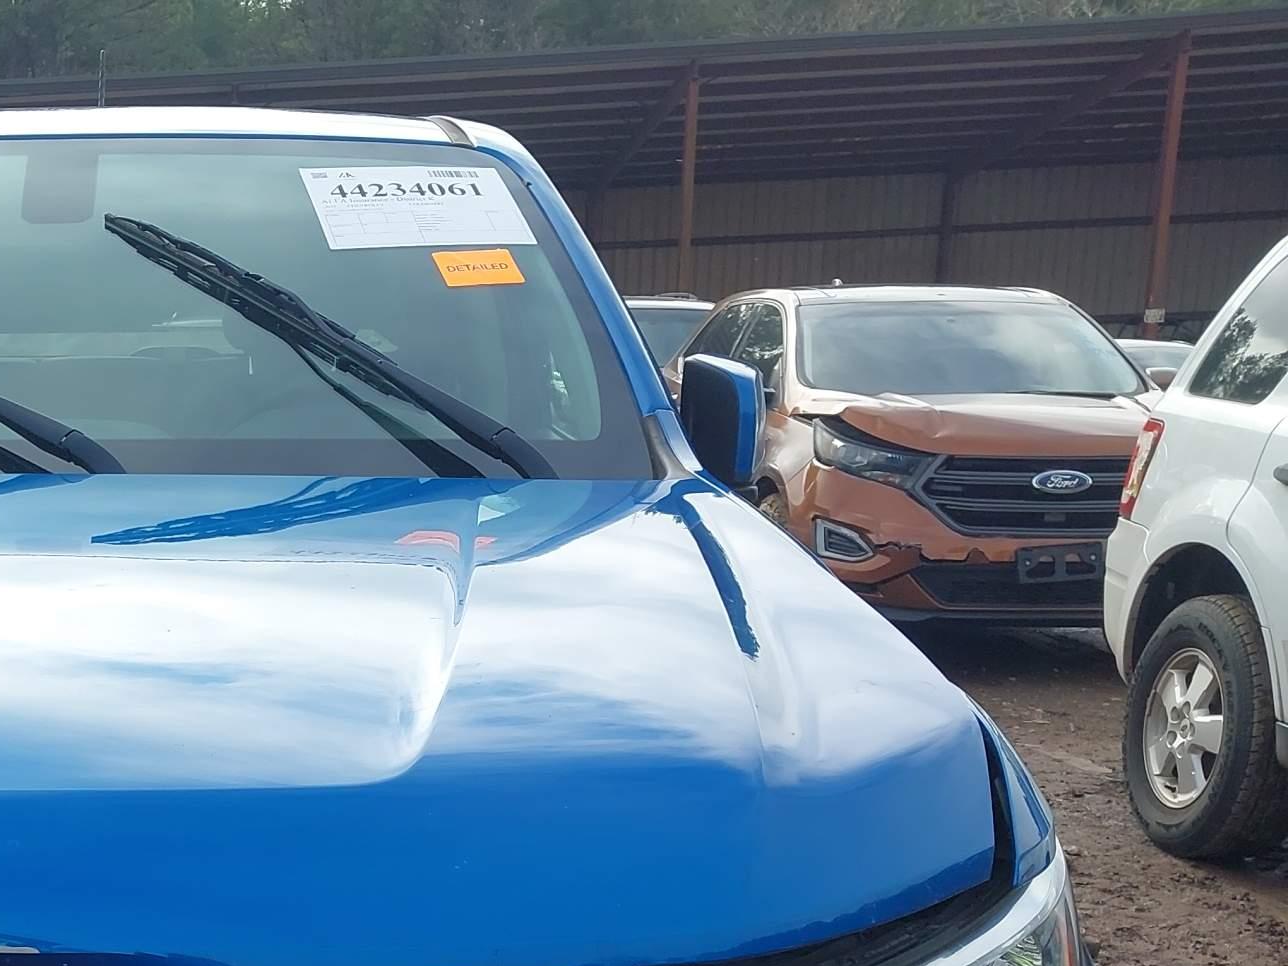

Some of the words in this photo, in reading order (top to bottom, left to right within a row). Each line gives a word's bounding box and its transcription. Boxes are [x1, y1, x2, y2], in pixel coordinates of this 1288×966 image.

[330, 182, 482, 198] 44234061
[447, 262, 509, 273] DETAILED
[1047, 475, 1079, 488] Ford
